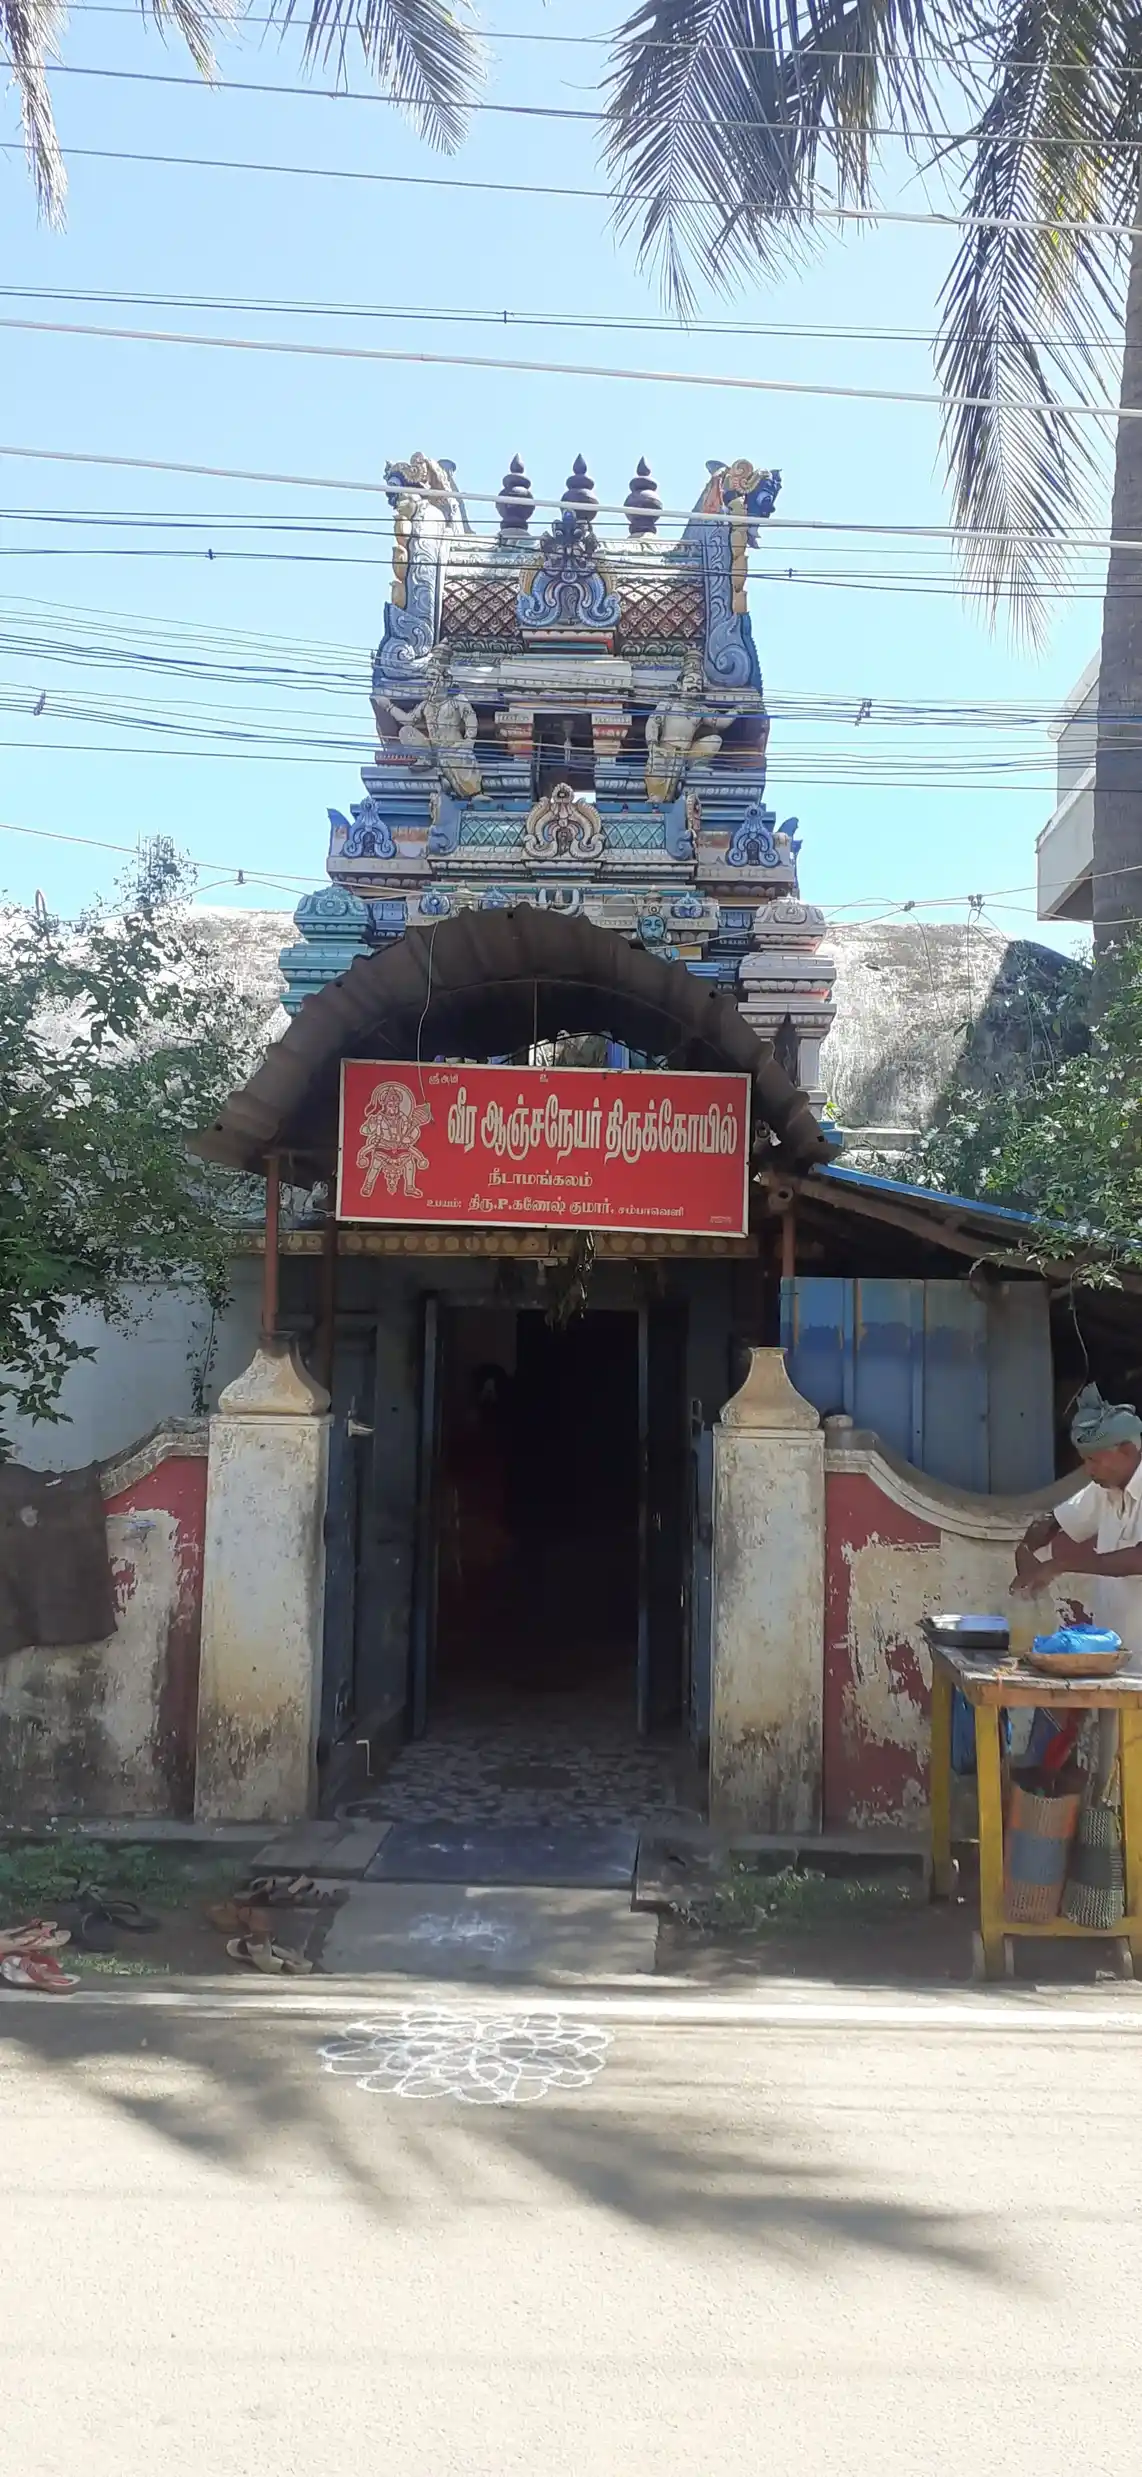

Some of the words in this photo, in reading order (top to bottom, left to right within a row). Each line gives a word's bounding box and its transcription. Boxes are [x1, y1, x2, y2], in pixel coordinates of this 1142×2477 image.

[447, 1086, 478, 1154] வீர
[481, 1093, 603, 1165] ஆஞ்சநேயர்
[604, 1098, 738, 1166] திருக்கோயில்
[488, 1167, 593, 1187] நீடாமங்கலம்
